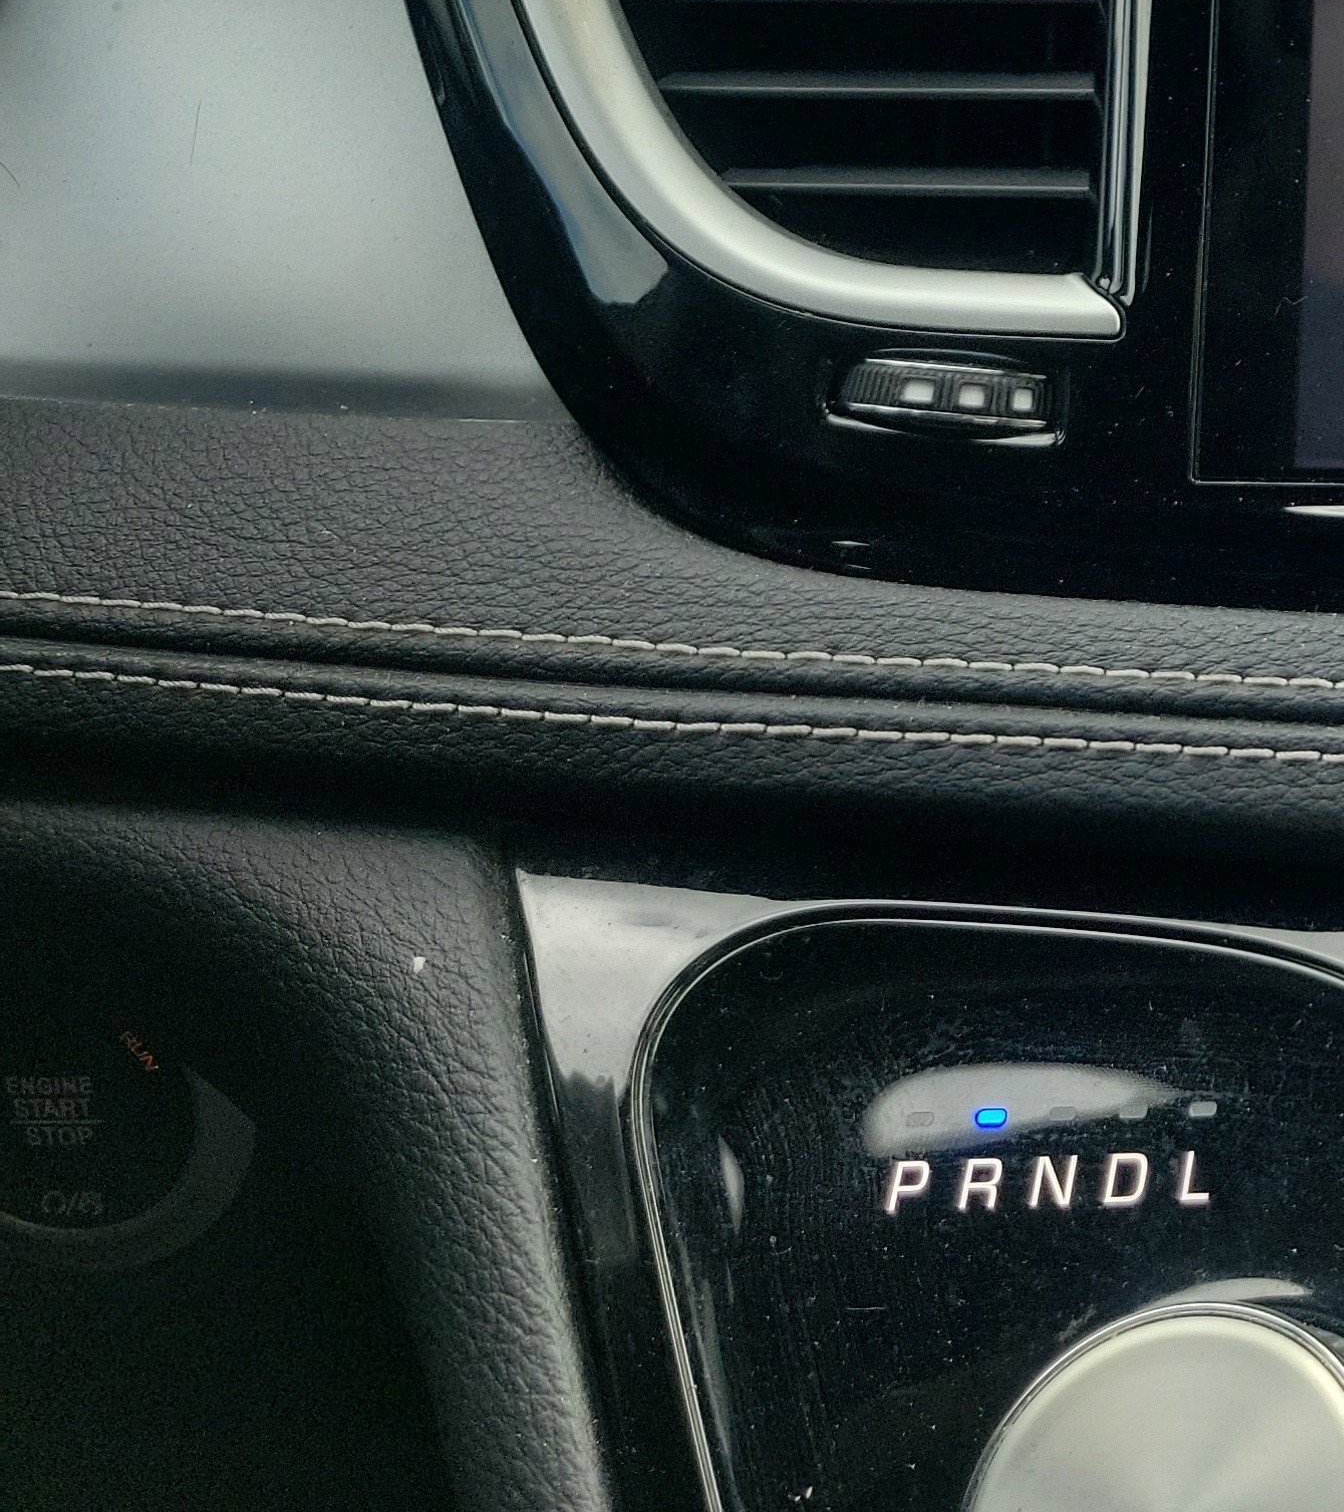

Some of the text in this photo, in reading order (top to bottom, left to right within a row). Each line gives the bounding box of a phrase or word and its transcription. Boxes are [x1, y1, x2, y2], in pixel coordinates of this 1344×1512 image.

[5, 1075, 94, 1095] ENGINE
[13, 1097, 91, 1118] START
[26, 1125, 94, 1146] STOP
